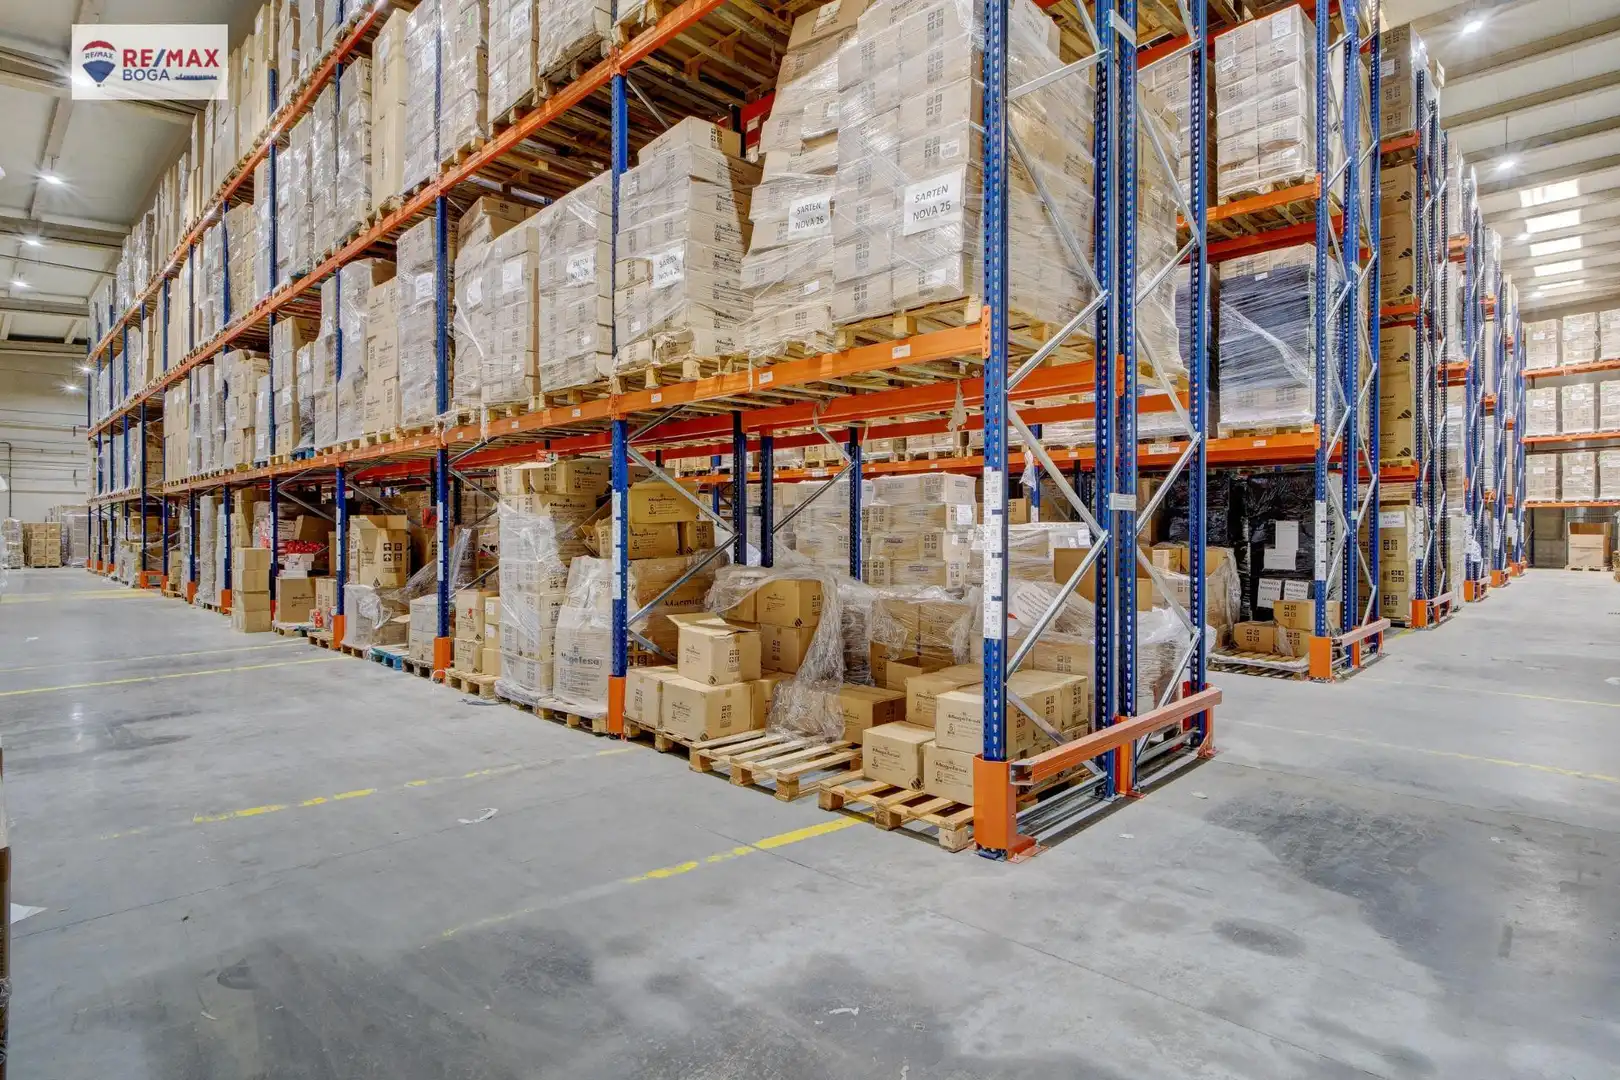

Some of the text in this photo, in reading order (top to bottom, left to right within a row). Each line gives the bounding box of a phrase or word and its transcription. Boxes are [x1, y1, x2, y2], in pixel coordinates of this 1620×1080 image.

[914, 184, 949, 203] SARTEN
[797, 203, 821, 215] SARTEN
[912, 200, 951, 221] NOVA 26
[795, 216, 825, 229] NOVA 26
[561, 651, 600, 666] Mgefesa
